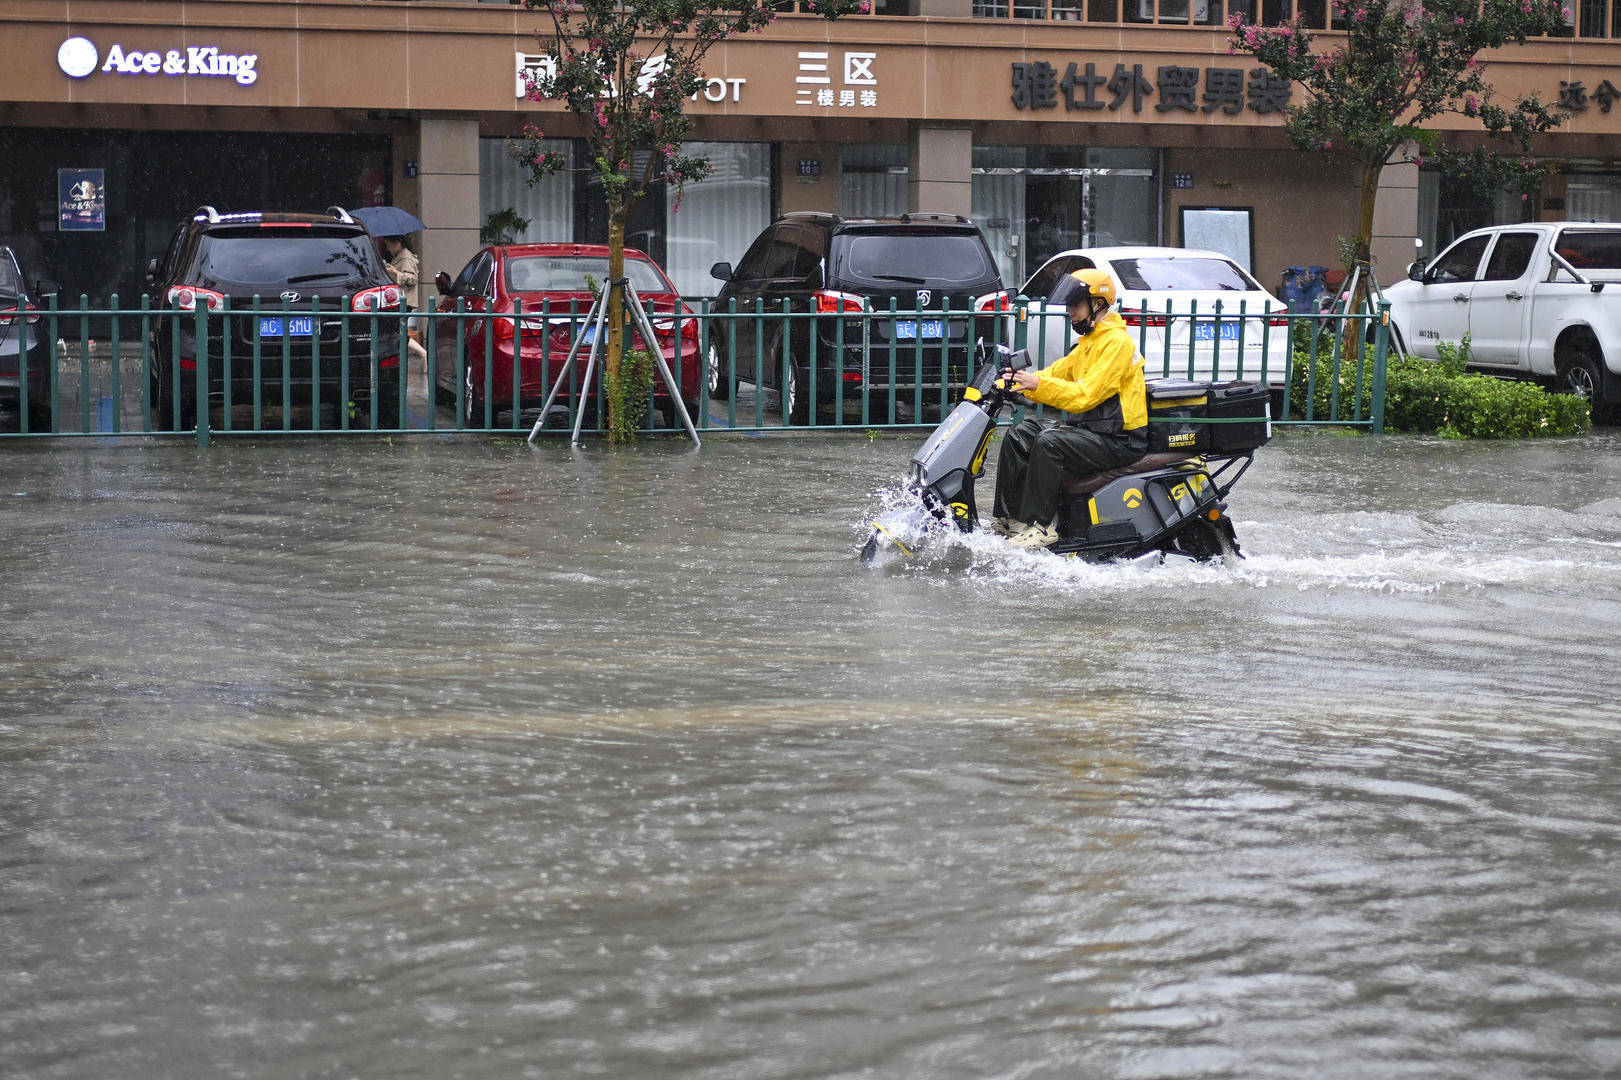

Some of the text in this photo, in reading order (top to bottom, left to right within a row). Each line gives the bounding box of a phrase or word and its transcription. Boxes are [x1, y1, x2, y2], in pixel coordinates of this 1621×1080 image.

[796, 52, 877, 85] 三区
[795, 89, 877, 107] 二楼男装
[1011, 61, 1293, 114] 雅仕外贸男装
